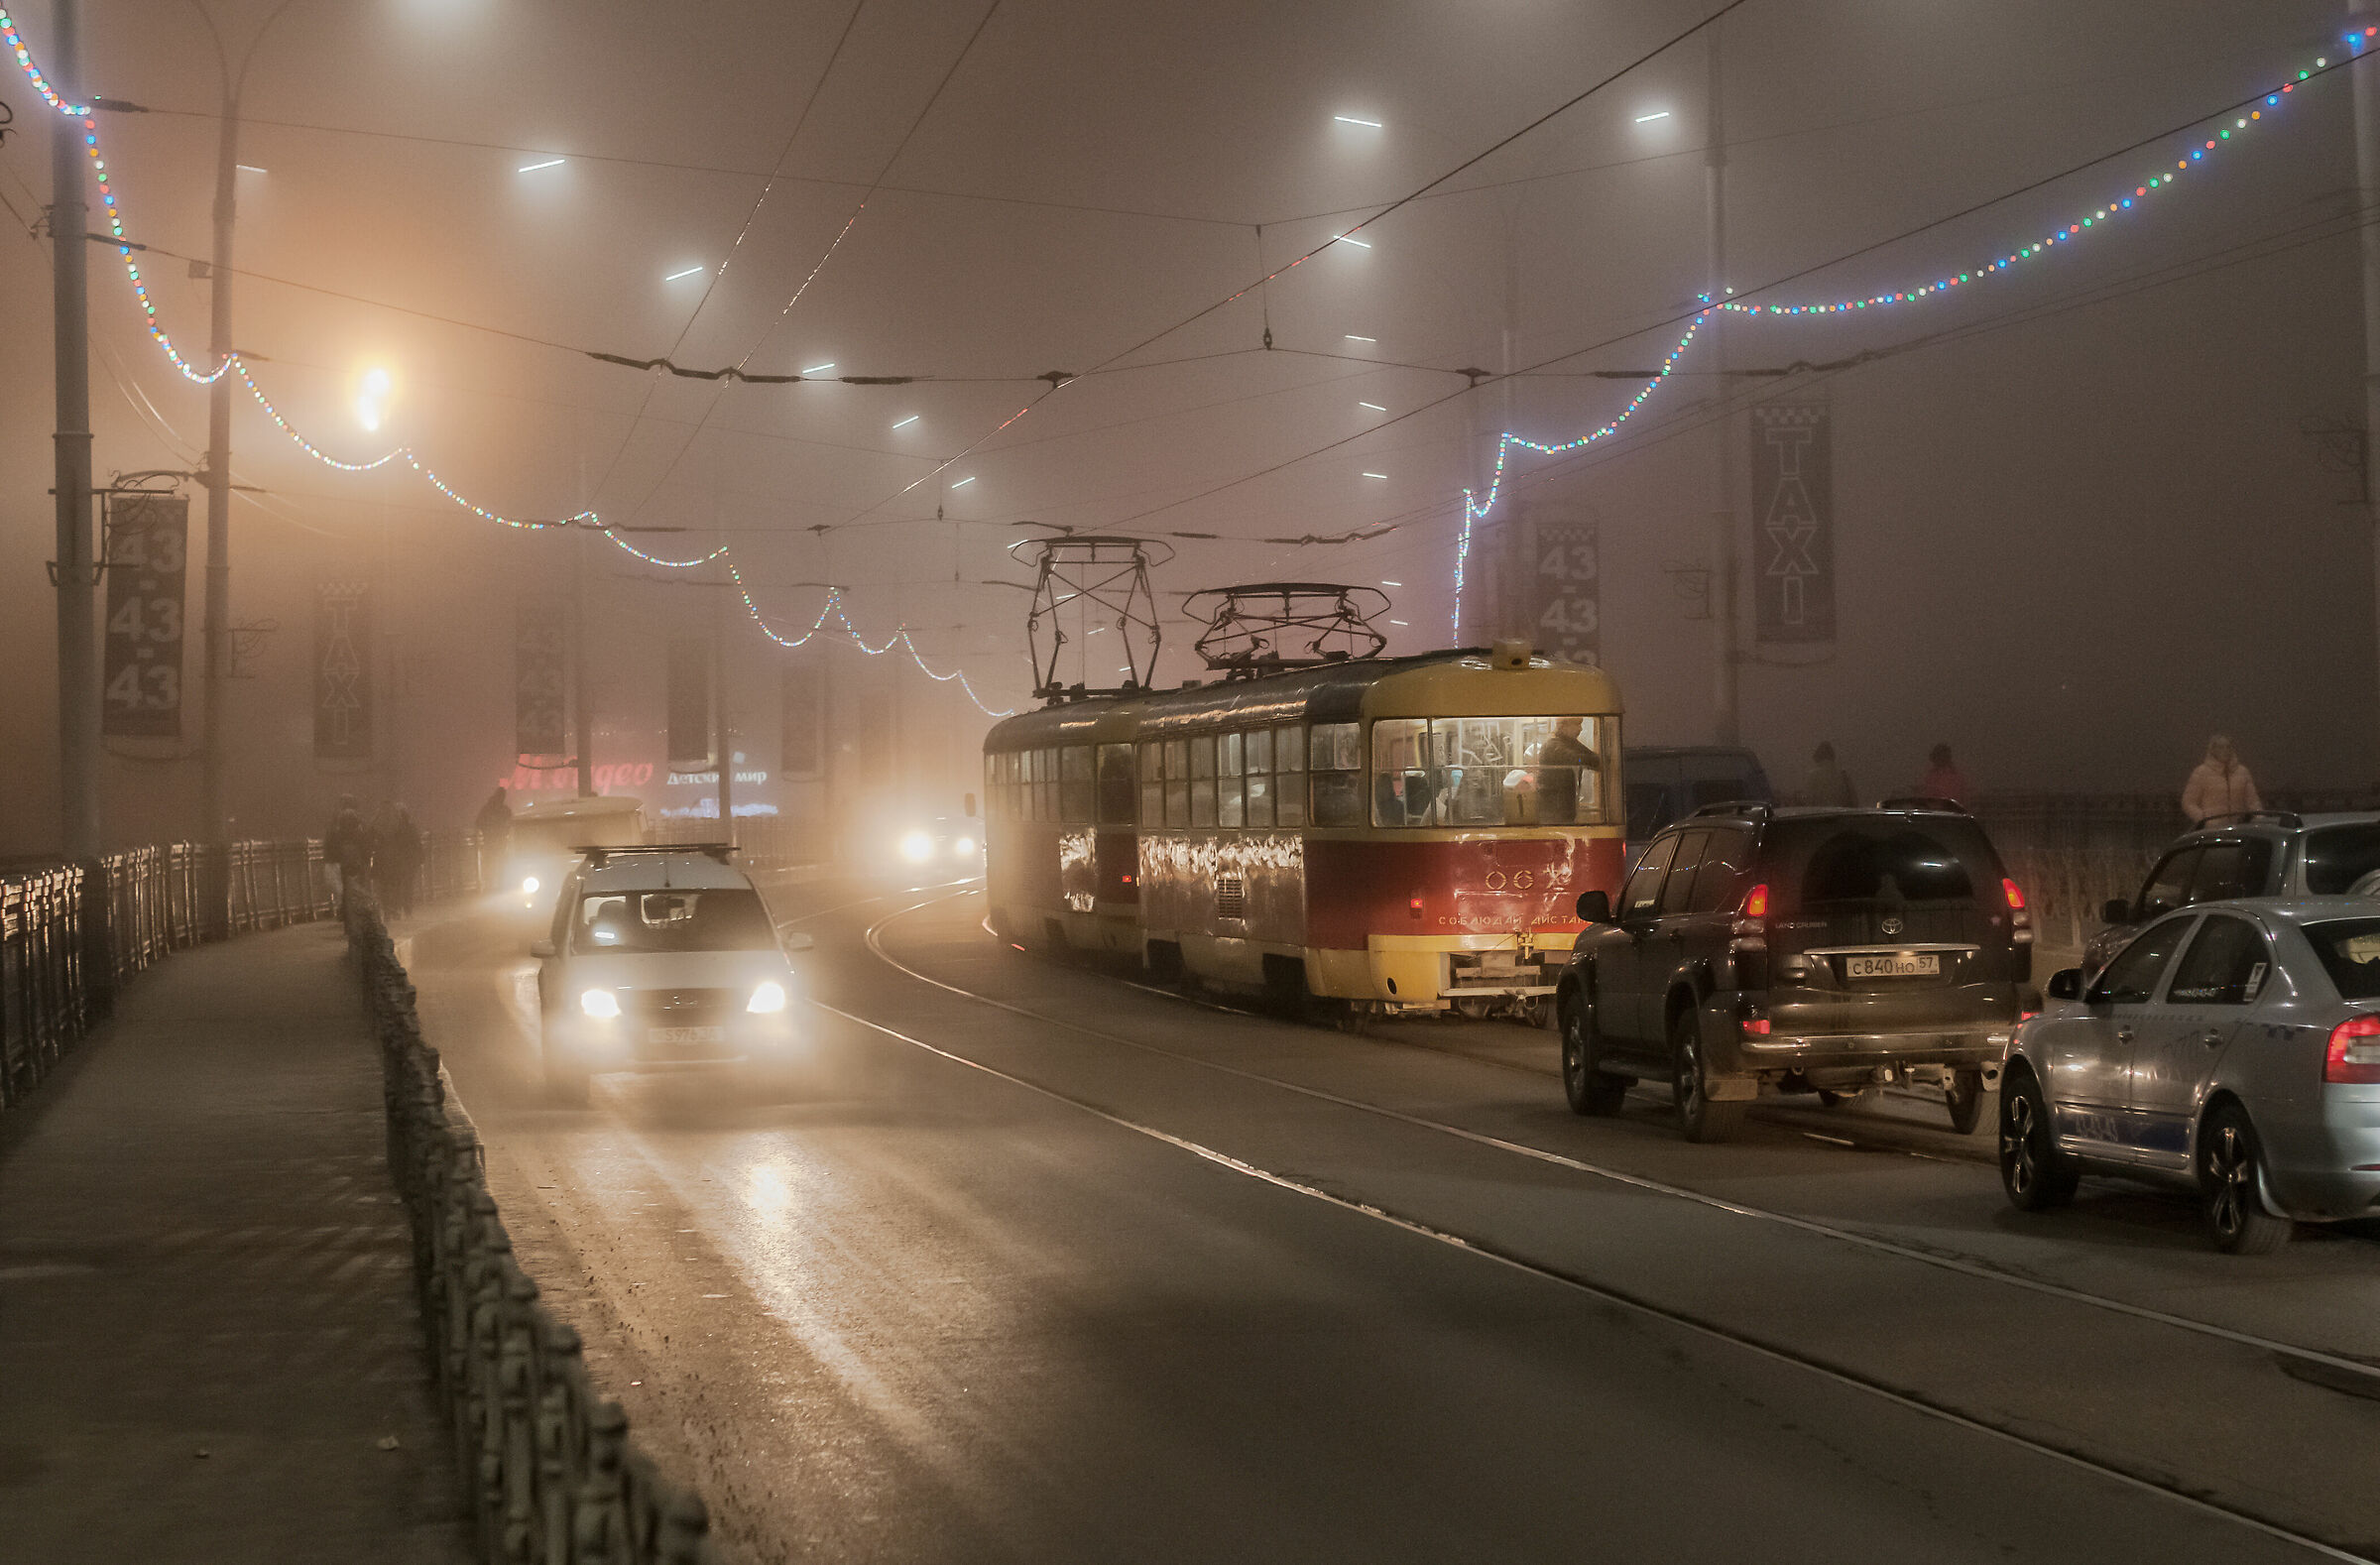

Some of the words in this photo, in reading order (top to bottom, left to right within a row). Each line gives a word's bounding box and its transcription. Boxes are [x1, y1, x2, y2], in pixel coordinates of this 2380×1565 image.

[1765, 426, 1819, 624] TAXI
[114, 528, 182, 573] 43
[1539, 544, 1597, 580] 43
[109, 597, 180, 643] 43
[1540, 598, 1598, 633] 43
[106, 664, 179, 709] 43
[734, 771, 768, 785] мир
[1438, 912, 1522, 925] СОБЛЮДАЙ
